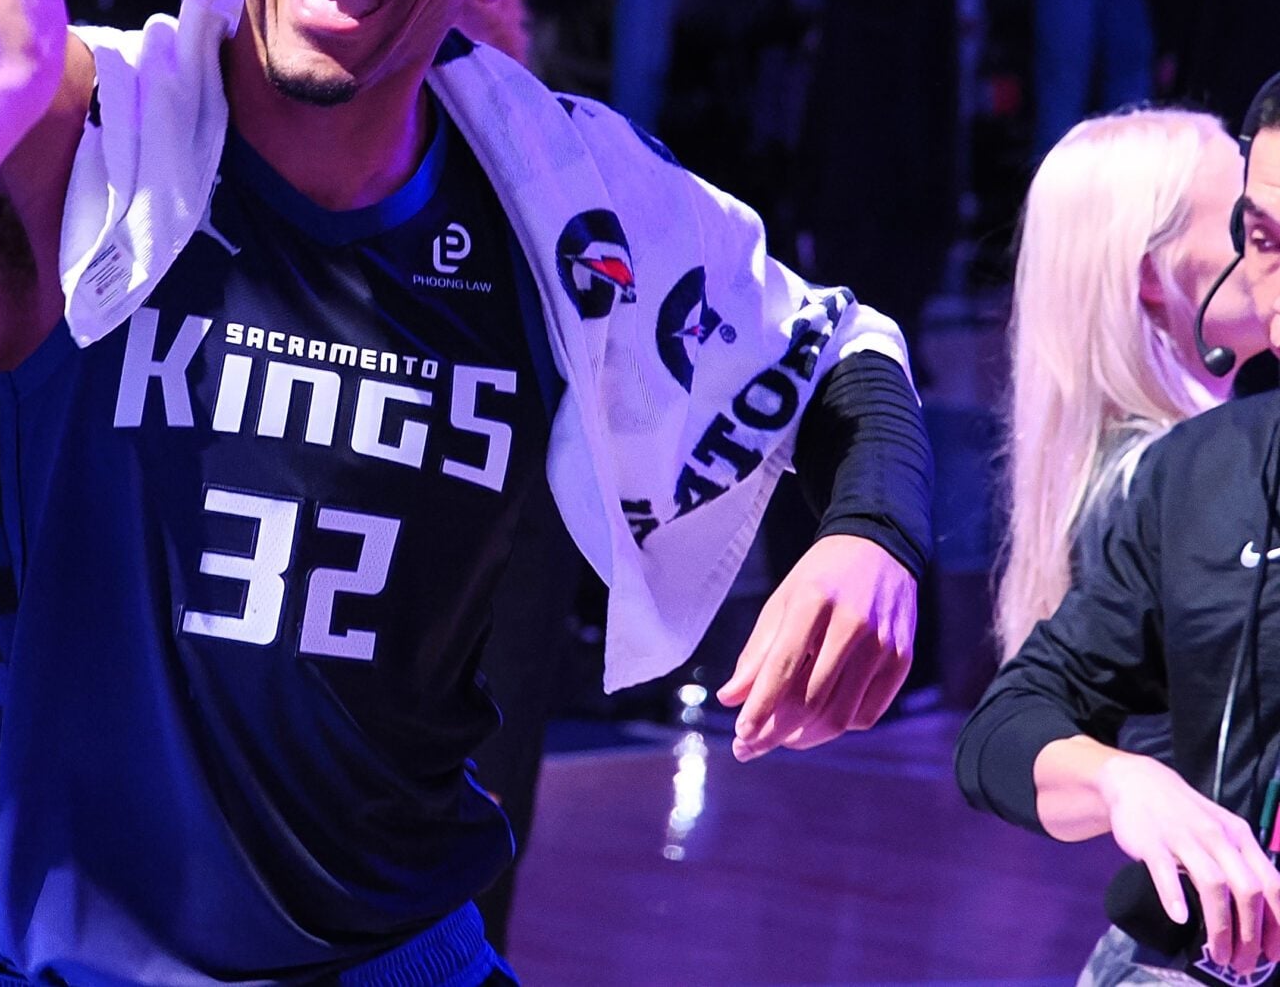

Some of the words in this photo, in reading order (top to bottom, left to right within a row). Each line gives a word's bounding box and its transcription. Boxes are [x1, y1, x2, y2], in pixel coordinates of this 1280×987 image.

[413, 274, 464, 290] PHOONG
[466, 280, 492, 293] LAW
[113, 307, 518, 493] KINGS
[225, 322, 439, 380] SACRAMENTO
[182, 488, 402, 661] 32
